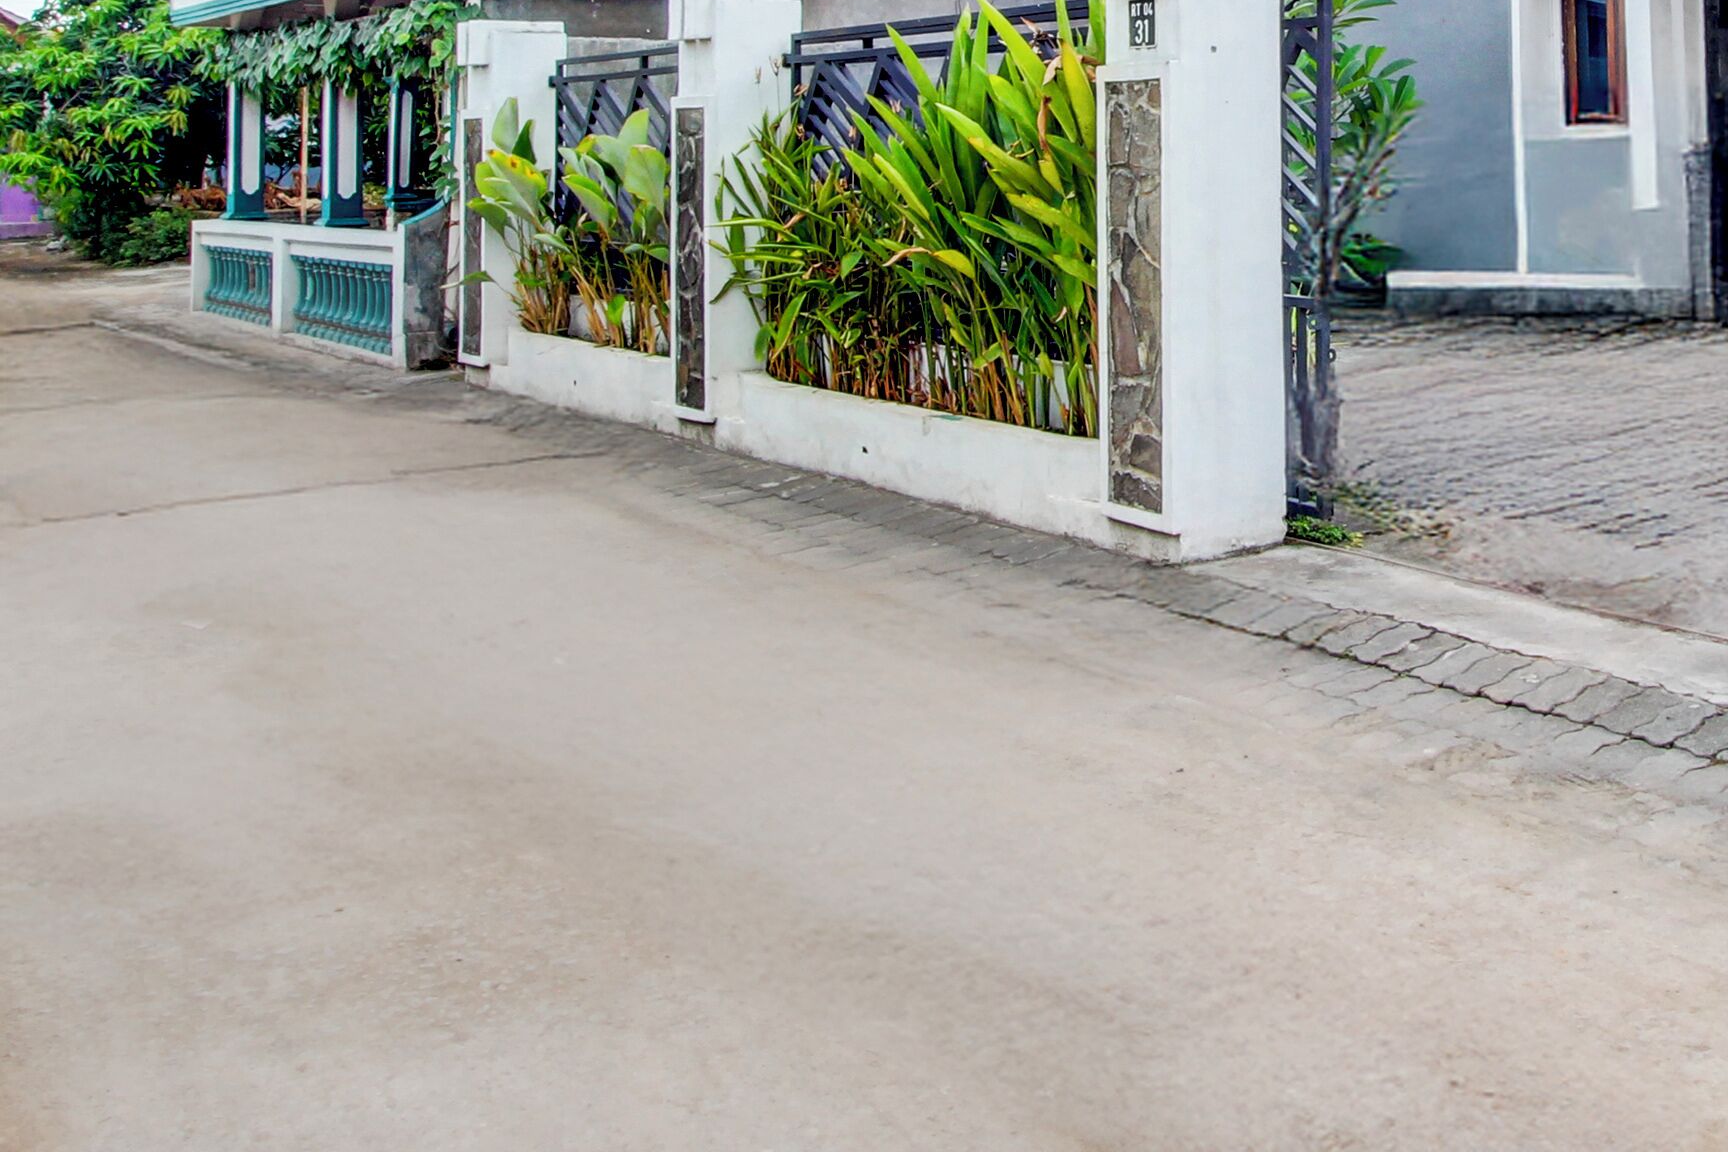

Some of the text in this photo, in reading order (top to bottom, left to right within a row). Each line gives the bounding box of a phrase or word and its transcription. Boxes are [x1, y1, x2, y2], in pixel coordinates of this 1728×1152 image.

[1131, 2, 1153, 16] RT 04
[1135, 19, 1149, 44] 31
